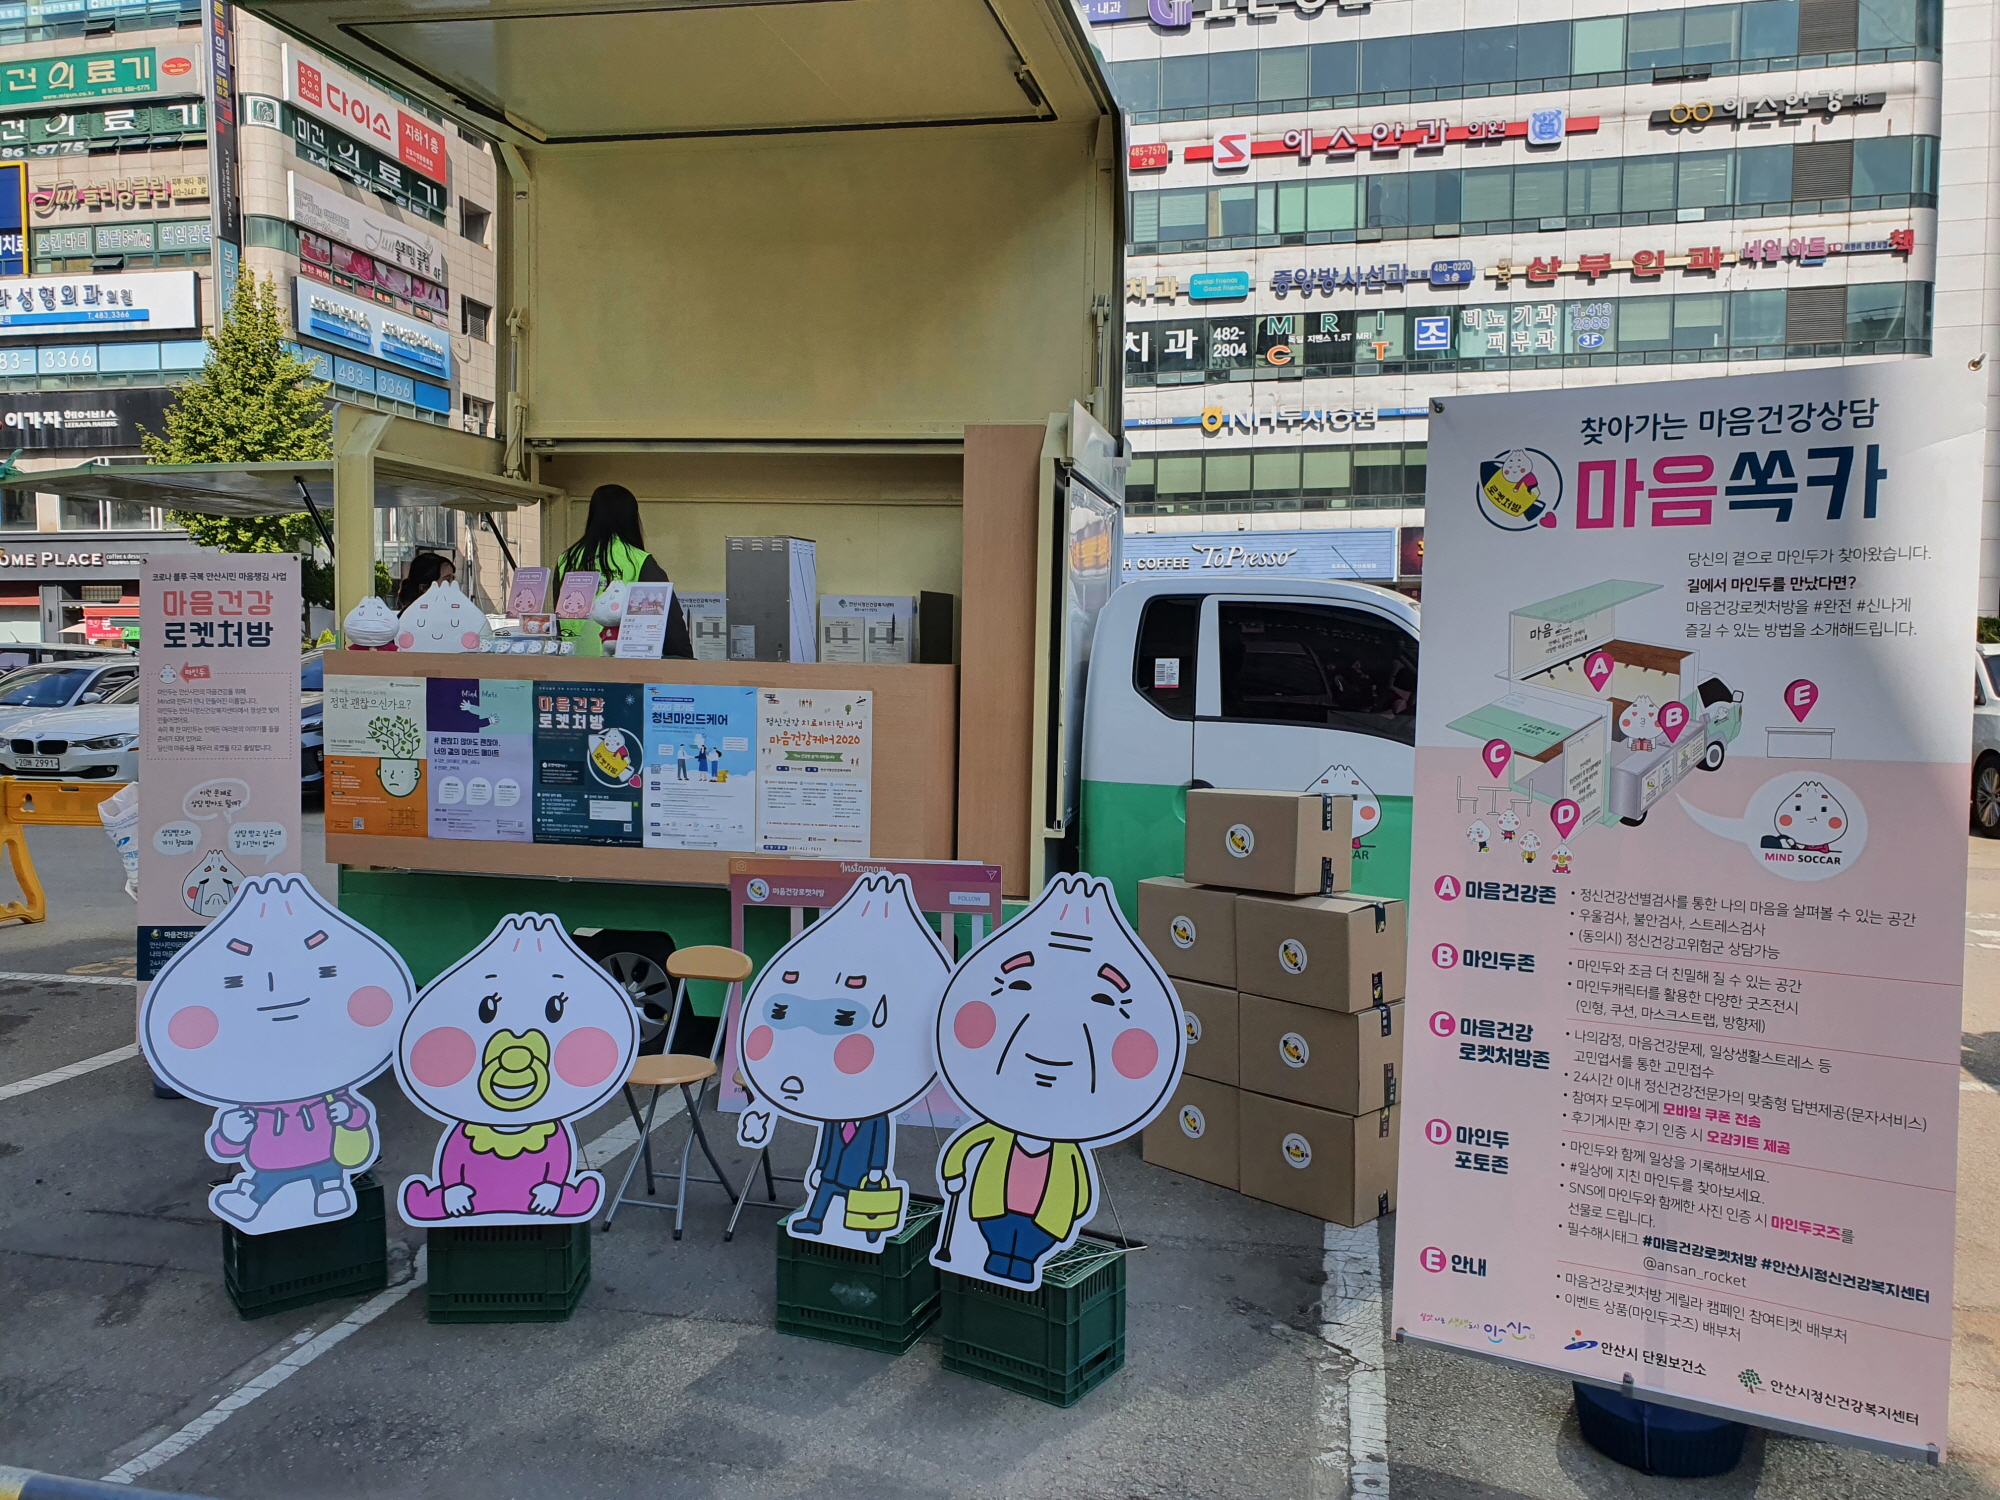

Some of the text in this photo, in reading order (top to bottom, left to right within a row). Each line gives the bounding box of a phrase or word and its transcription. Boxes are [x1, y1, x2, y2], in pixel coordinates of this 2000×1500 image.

[0, 56, 149, 92] 건의료기
[326, 83, 391, 141] 다이소
[1722, 88, 1845, 119] 에스안경
[405, 123, 439, 154] 지하1층
[1282, 118, 1507, 158] 에스안과 의원
[1130, 145, 1166, 158] 485-7570
[82, 176, 169, 206] 슬리밍클럽
[97, 230, 120, 249] 한달
[1744, 236, 1828, 262] 네일 아트
[1889, 229, 1914, 255] 책
[1434, 262, 1471, 273] 480-0220
[1526, 246, 1723, 282] 산부인과
[1272, 263, 1428, 294] 중앙방사선과 의원
[1444, 272, 1460, 282] 3층
[88, 311, 130, 320] T.483.3366
[1462, 304, 1558, 329] 비뇨기과
[1570, 303, 1612, 318] T.413
[1214, 327, 1245, 341] 482-
[1418, 320, 1447, 347] 조
[1573, 317, 1610, 332] 2888
[1288, 331, 1372, 344] 독일 지멘스 1.5T MRI
[1487, 329, 1557, 353] 피부과
[1582, 333, 1601, 347] 3F
[45, 352, 92, 368] 3366
[1213, 343, 1247, 358] 2804
[338, 363, 410, 399] 483- 3366
[5, 411, 63, 429] 이가자
[64, 410, 117, 420] 헤어비스
[1229, 402, 1379, 429] NH투자증권
[1580, 398, 1880, 446] 찾아가는 마음건강상담
[1575, 443, 1888, 531] 마음쏙카
[1485, 483, 1523, 518] 로켓처방
[41, 552, 104, 566] PLACE
[1137, 545, 1290, 570] COFFEE ToPresso
[1687, 544, 1933, 568] 당신의 곁으로 마인두가 찾아왔습니다.
[152, 573, 171, 582] 코로나
[173, 573, 187, 581] 블루
[189, 573, 204, 581] 극복
[206, 572, 237, 582] 안산시민
[271, 572, 287, 581] 사업
[1687, 574, 1857, 593] 길에서 마인두를 만났다면?
[163, 590, 274, 616] 마음건강
[1685, 596, 1912, 616] 마음건강로켓처방을 #완전 #신나게
[163, 620, 274, 648] 로켓처방
[1685, 619, 1918, 639] 즐길 수 있는 방법을 소개해드립니다.
[184, 668, 206, 677] 마인두
[330, 696, 412, 711] 정말 괜찮으신가요?
[461, 690, 477, 698] Mind
[538, 696, 606, 713] 마음건강
[651, 713, 728, 726] 청년마인드케어
[652, 703, 695, 712] 2020 경기도
[538, 713, 604, 730] 로켓처방
[766, 717, 862, 729] 정신건강 치료비지원 사업
[440, 737, 458, 745] 괜찮지
[460, 738, 479, 746] 않아도
[480, 738, 500, 747] 괜찮아.
[770, 731, 860, 747] 마음건강케어 2020
[35, 759, 53, 767] 2991
[434, 747, 446, 755] 너의
[462, 748, 480, 756] 마인드
[481, 748, 500, 757] 메이트
[1764, 851, 1842, 866] MIND SOCCAR
[772, 887, 825, 898] 마음건강로켓처방
[1465, 880, 1557, 905] 마음건강존
[1579, 888, 1916, 928] 정신건강선별검사를 통한 나의 마음을 살펴볼 수 있는 공간
[1578, 929, 1780, 960] (동의시) 정신건강고위험군 상담가능
[1462, 948, 1536, 973] 마인두존
[1460, 1017, 1534, 1043] 마음건강
[1458, 1041, 1550, 1070] 로켓처방존
[1456, 1125, 1510, 1150] 마인두
[1454, 1150, 1509, 1175] 포토존
[1451, 1254, 1487, 1277] 안내
[1567, 1221, 1931, 1304] 필수해시태그 #마음건강로켓처방 #안산시정신건강복지센터
[1642, 1255, 1747, 1289] @ansan_rocket
[1565, 1273, 1848, 1345] 마음건강로켓처방 게릴라 캠페인 참여티켓 배부처
[1601, 1341, 1707, 1377] 안산시 단원보건소
[1770, 1378, 1920, 1427] 안산시정신건강복지센터
